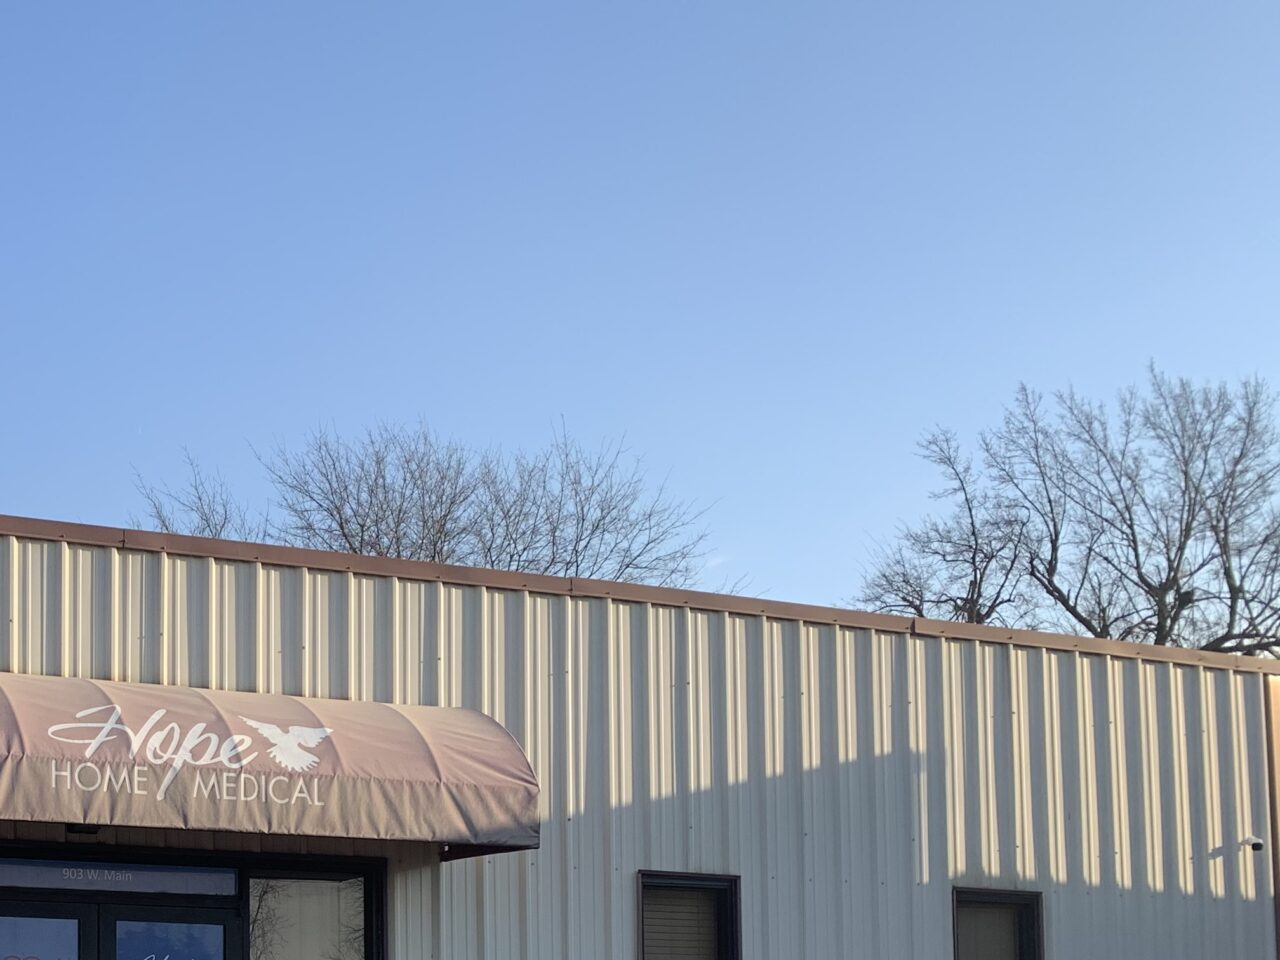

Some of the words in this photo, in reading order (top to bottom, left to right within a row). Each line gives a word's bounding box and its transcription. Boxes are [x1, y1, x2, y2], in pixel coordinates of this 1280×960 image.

[48, 704, 259, 800] Hope
[51, 759, 148, 795] HOME
[193, 770, 325, 805] MEDICAL
[62, 868, 83, 880] 903
[104, 870, 132, 880] Main
